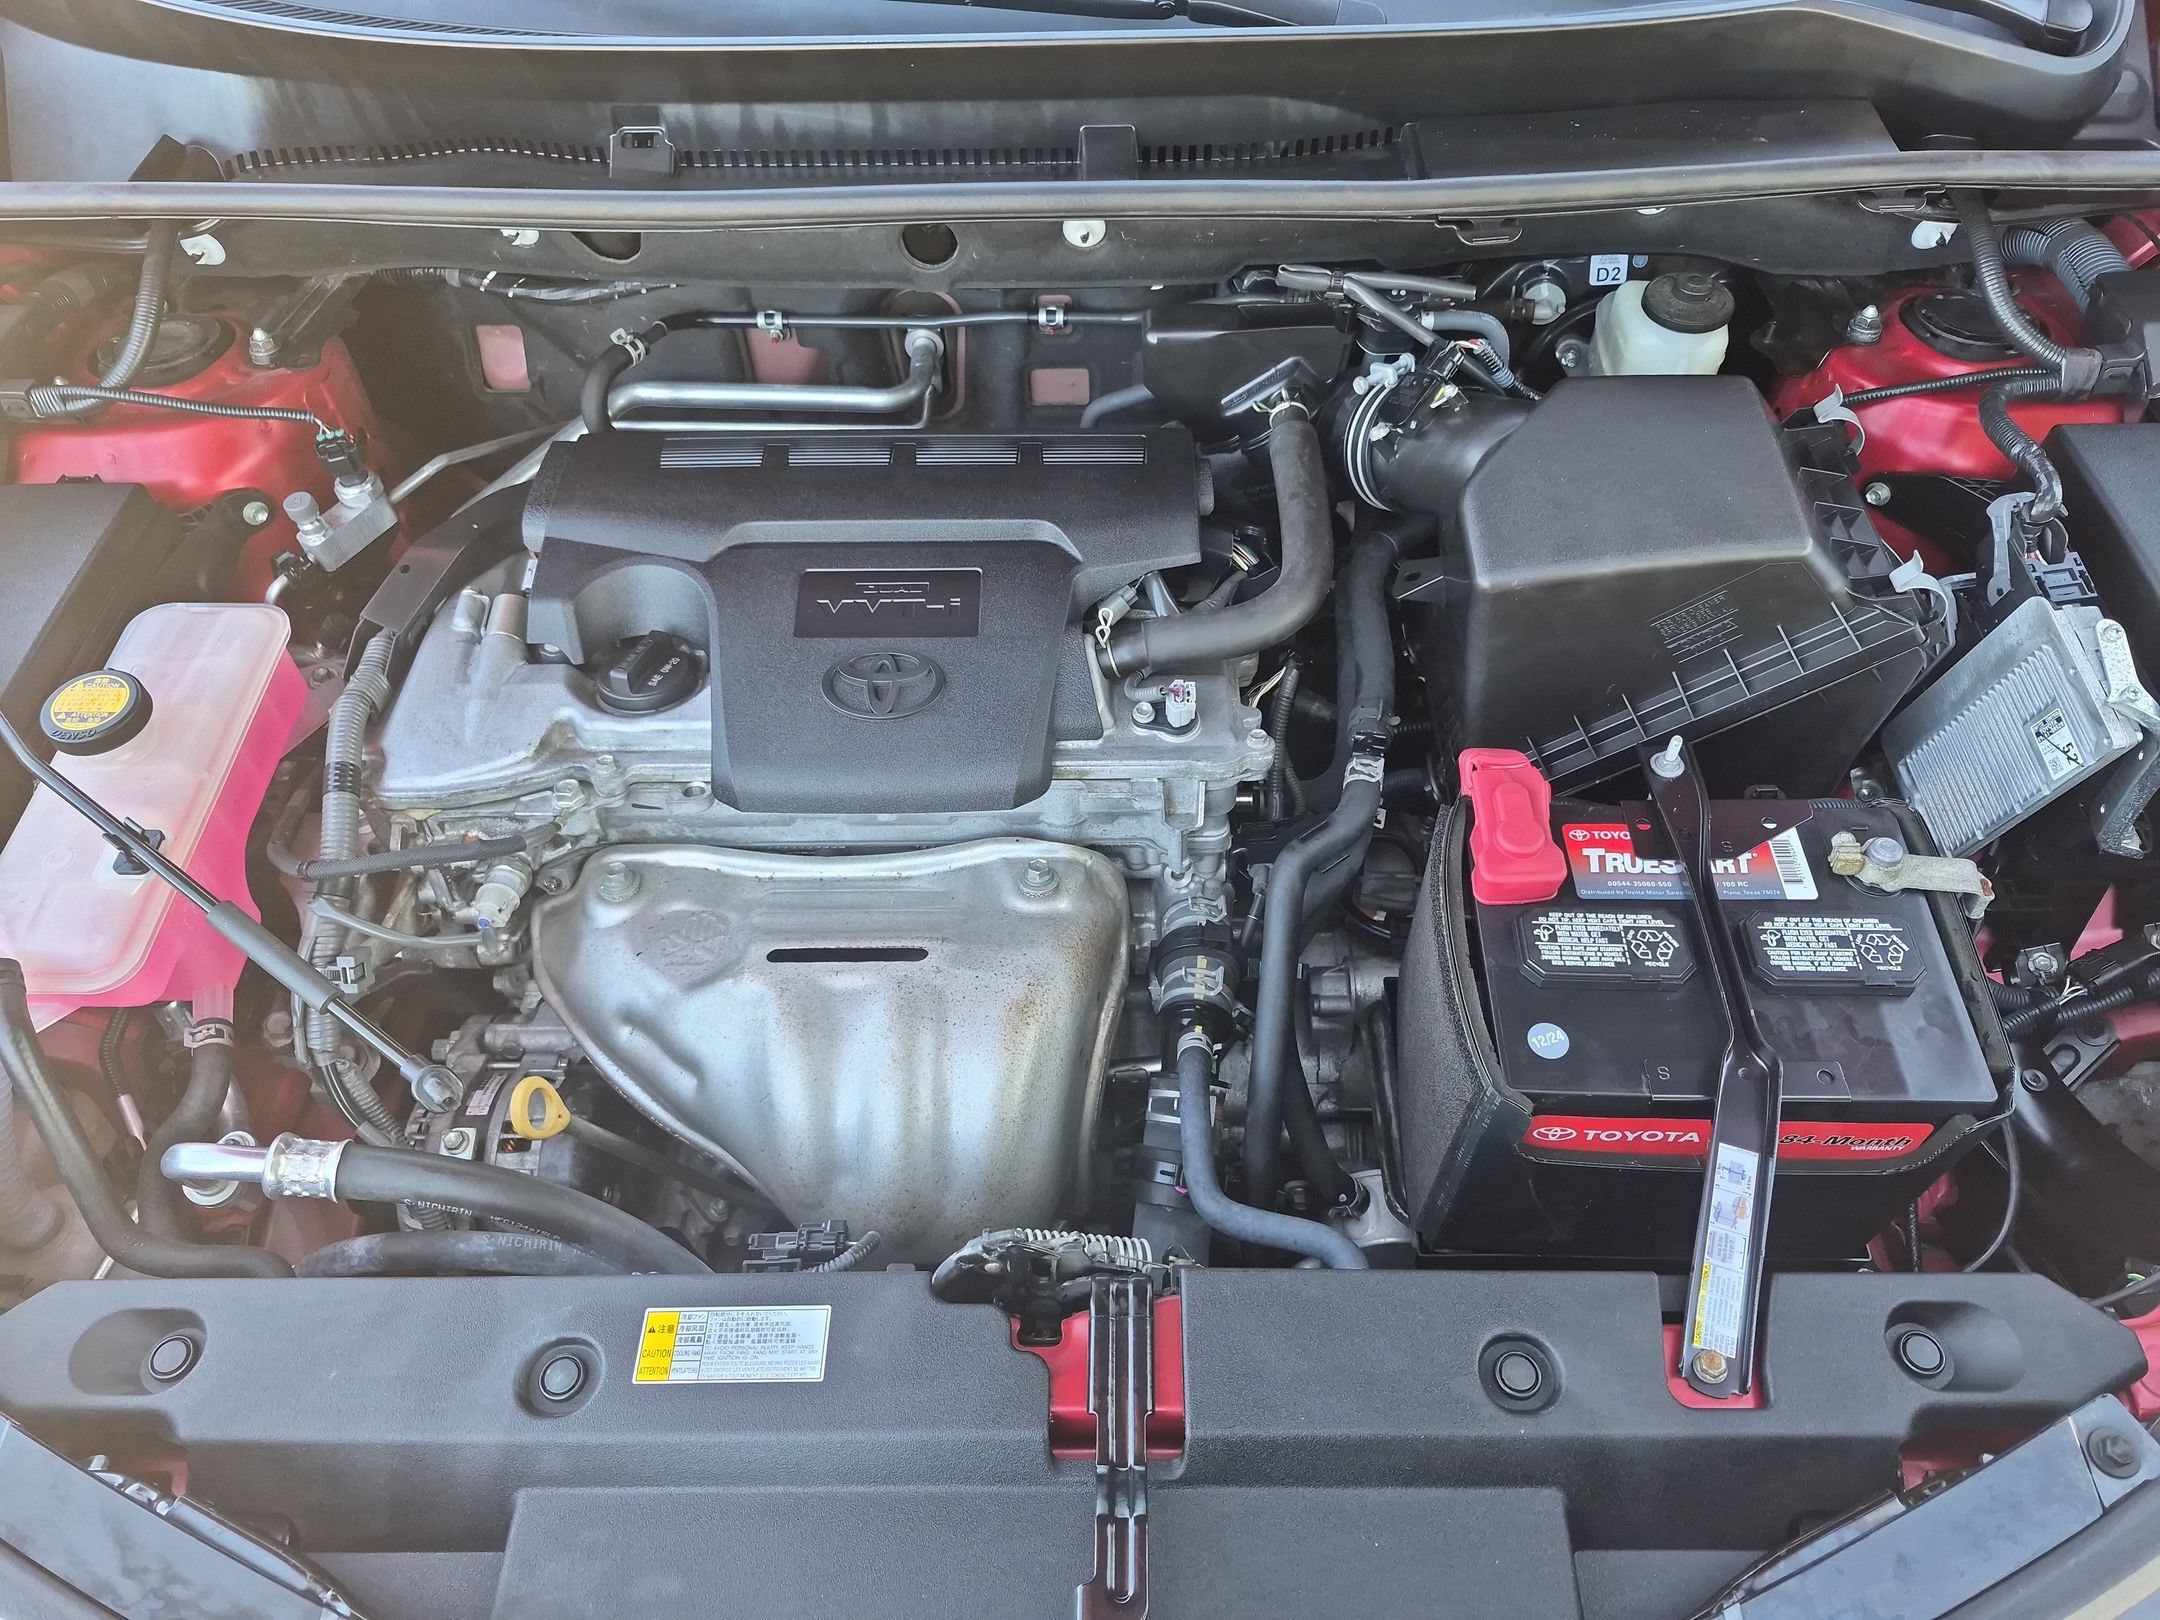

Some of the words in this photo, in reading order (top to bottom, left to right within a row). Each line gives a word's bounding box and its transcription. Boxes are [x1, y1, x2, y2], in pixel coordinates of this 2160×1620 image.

[1596, 266, 1621, 282] D2
[648, 674, 664, 686] SAE
[50, 729, 97, 740] DENSO
[1592, 831, 1630, 840] TOYO
[1531, 1030, 1565, 1049] 12/24
[1584, 1130, 1700, 1142] TOYOTA
[1778, 1134, 1913, 1146] 84-Month
[657, 1324, 675, 1334] 注意
[642, 1349, 672, 1358] CAUTION
[639, 1367, 668, 1375] ATTENTION
